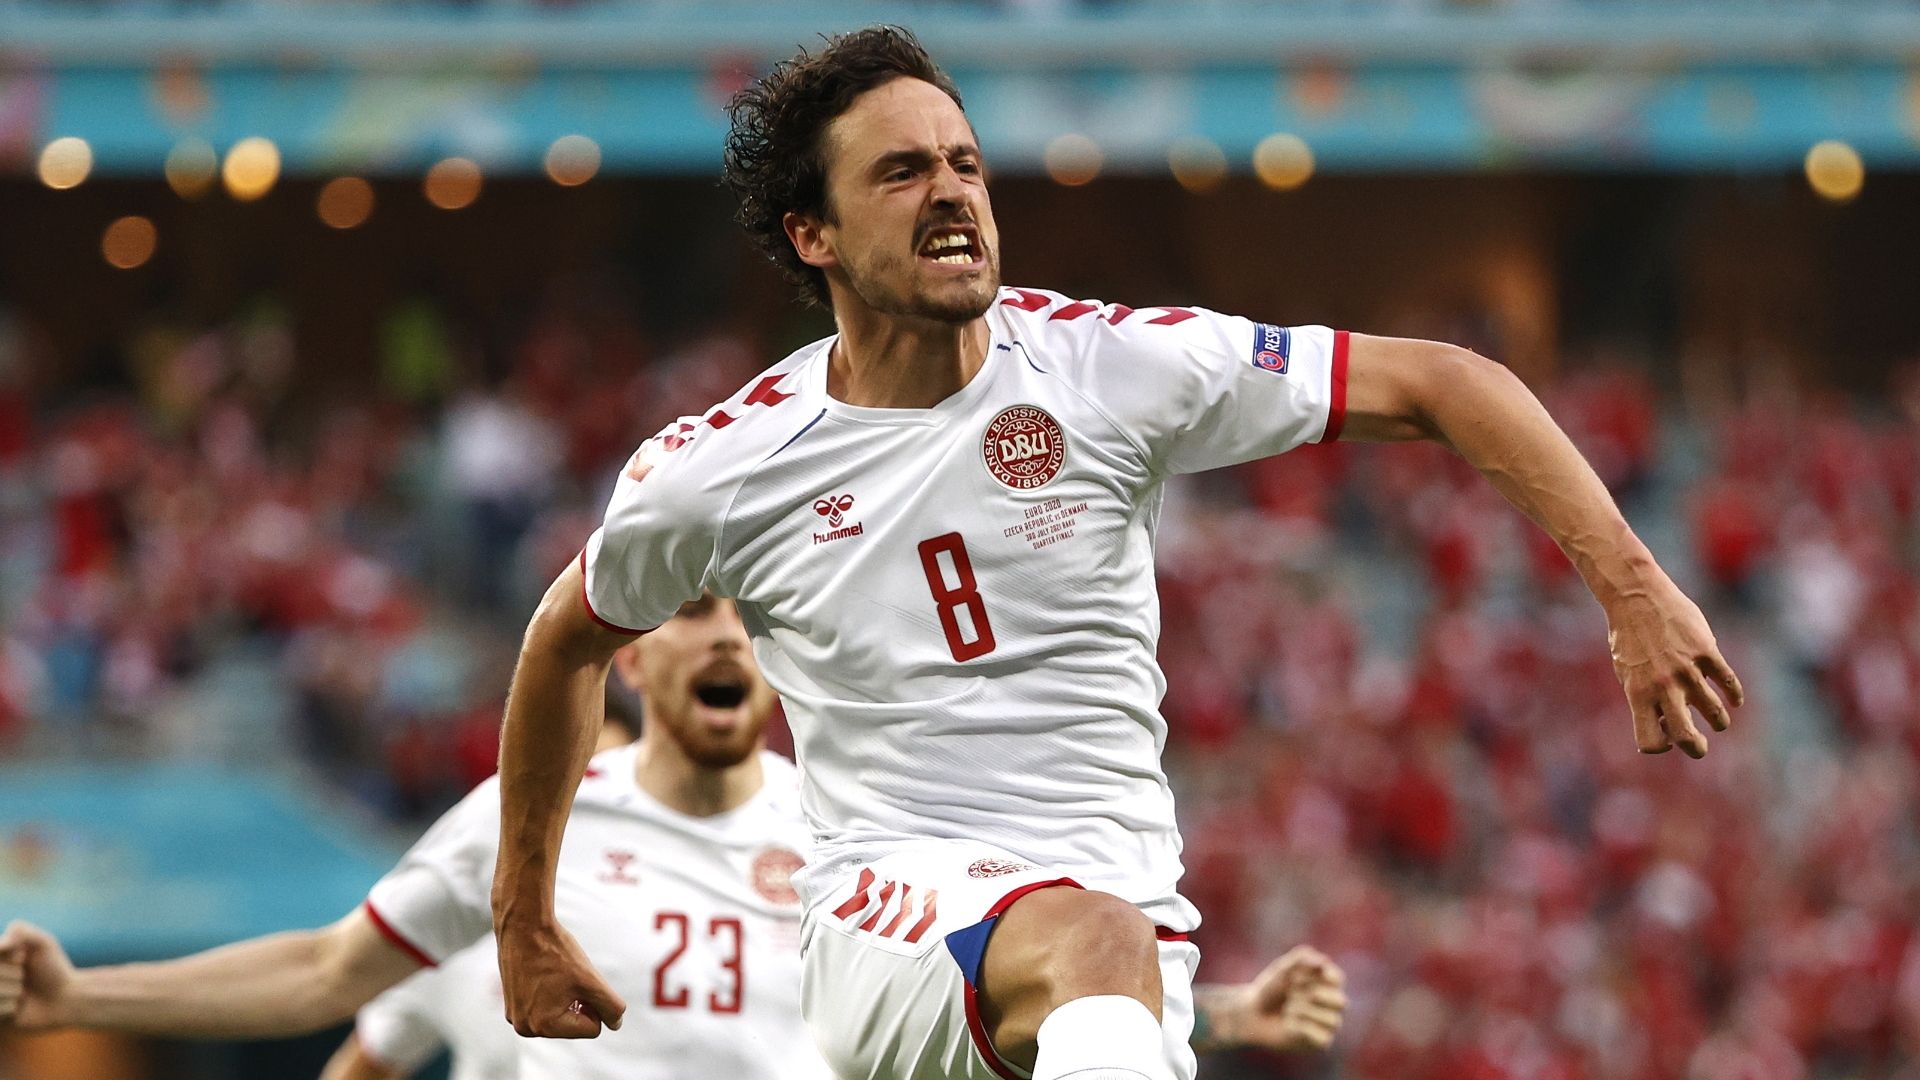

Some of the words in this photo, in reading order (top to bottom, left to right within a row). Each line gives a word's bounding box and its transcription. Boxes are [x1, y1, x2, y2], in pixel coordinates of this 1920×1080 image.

[985, 436, 1011, 483] DANSK
[998, 431, 1050, 462] DBU
[1016, 472, 1048, 488] 1889
[1004, 525, 1024, 538] CZECH
[1024, 514, 1054, 531] REPUBLIC
[1061, 502, 1089, 519] DENMARK
[1024, 505, 1043, 519] EURO
[1044, 499, 1062, 512] 2020
[813, 521, 863, 545] hummel
[1032, 538, 1056, 550] QUARTER
[1056, 530, 1075, 541] FINALS
[1037, 529, 1050, 538] JULY
[1050, 524, 1062, 534] 2021
[918, 531, 996, 663] 8
[653, 912, 742, 1014] 23
